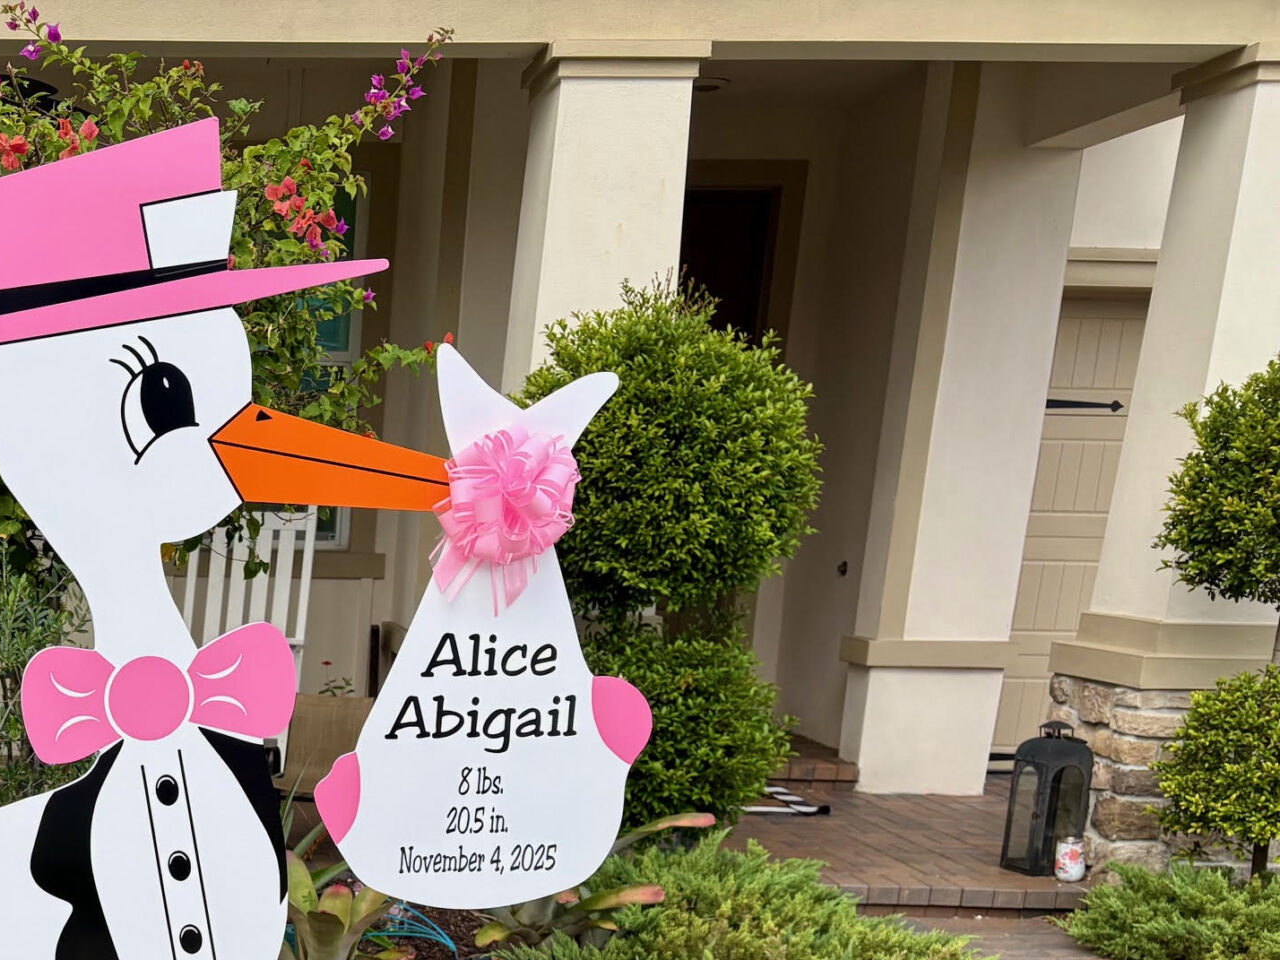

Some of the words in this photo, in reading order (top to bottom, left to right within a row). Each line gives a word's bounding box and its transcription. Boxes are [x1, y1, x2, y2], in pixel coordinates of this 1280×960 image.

[421, 633, 557, 677] Alice
[385, 695, 576, 753] Abigail
[459, 767, 472, 795] 8
[476, 767, 503, 794] lbs.
[446, 807, 484, 834] 20.5
[490, 807, 508, 833] in.
[399, 845, 485, 873] November
[490, 846, 504, 874] 4,
[510, 844, 556, 871] 2025
